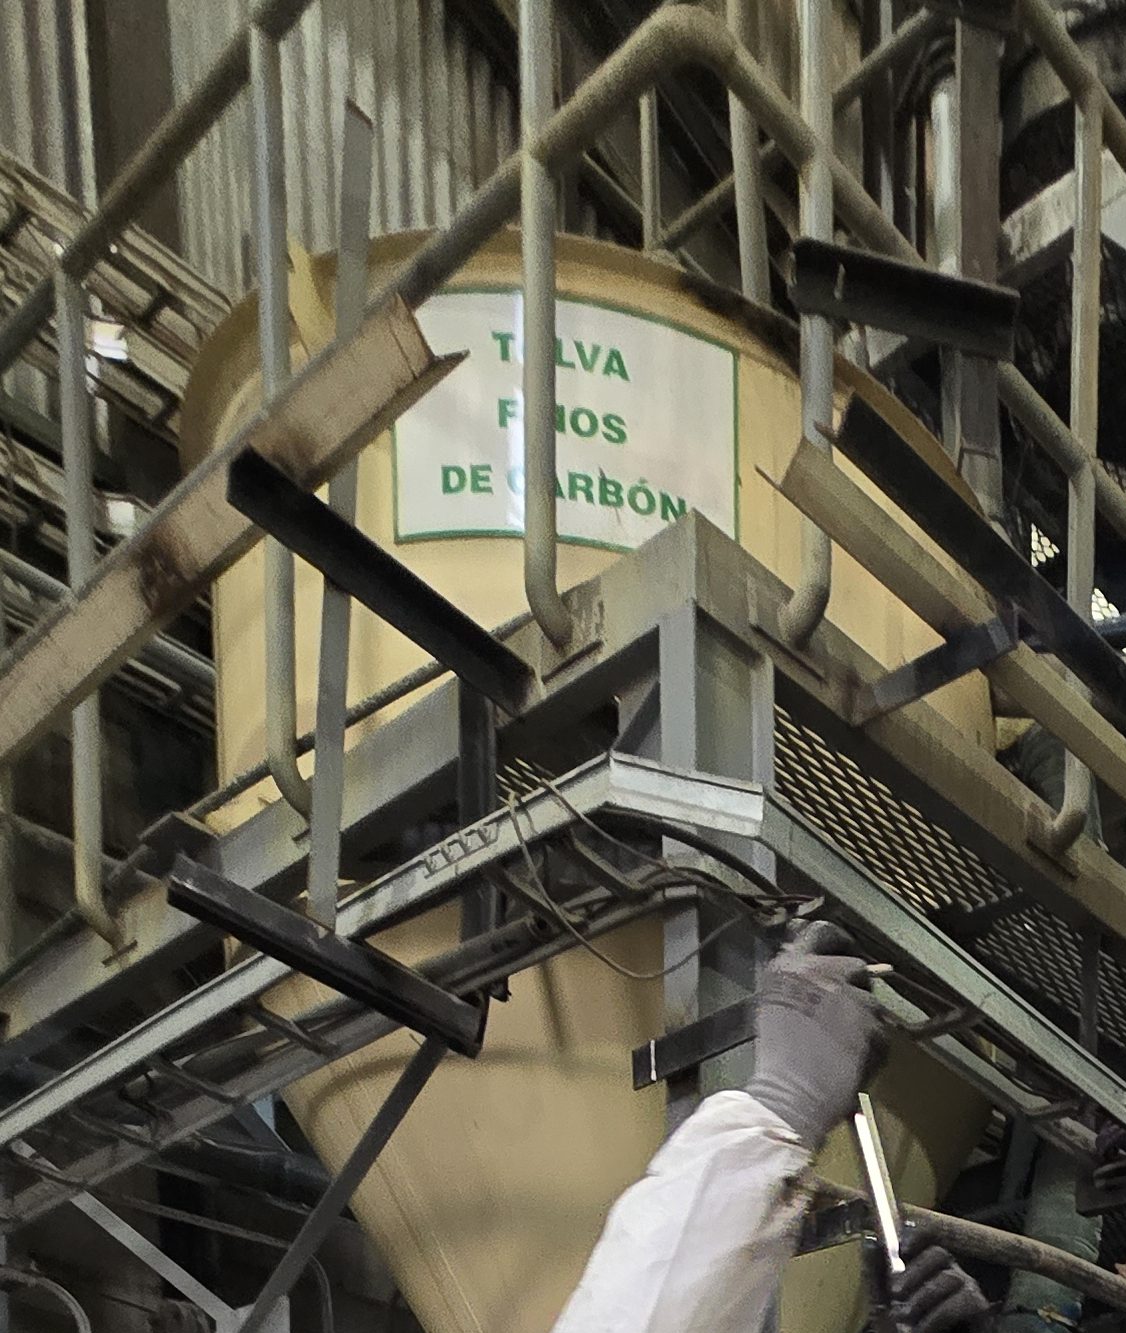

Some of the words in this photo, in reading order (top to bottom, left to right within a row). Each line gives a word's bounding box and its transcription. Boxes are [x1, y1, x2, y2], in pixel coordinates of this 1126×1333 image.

[491, 331, 630, 382] TLVA
[498, 398, 628, 444] FOS
[441, 464, 493, 495] DE
